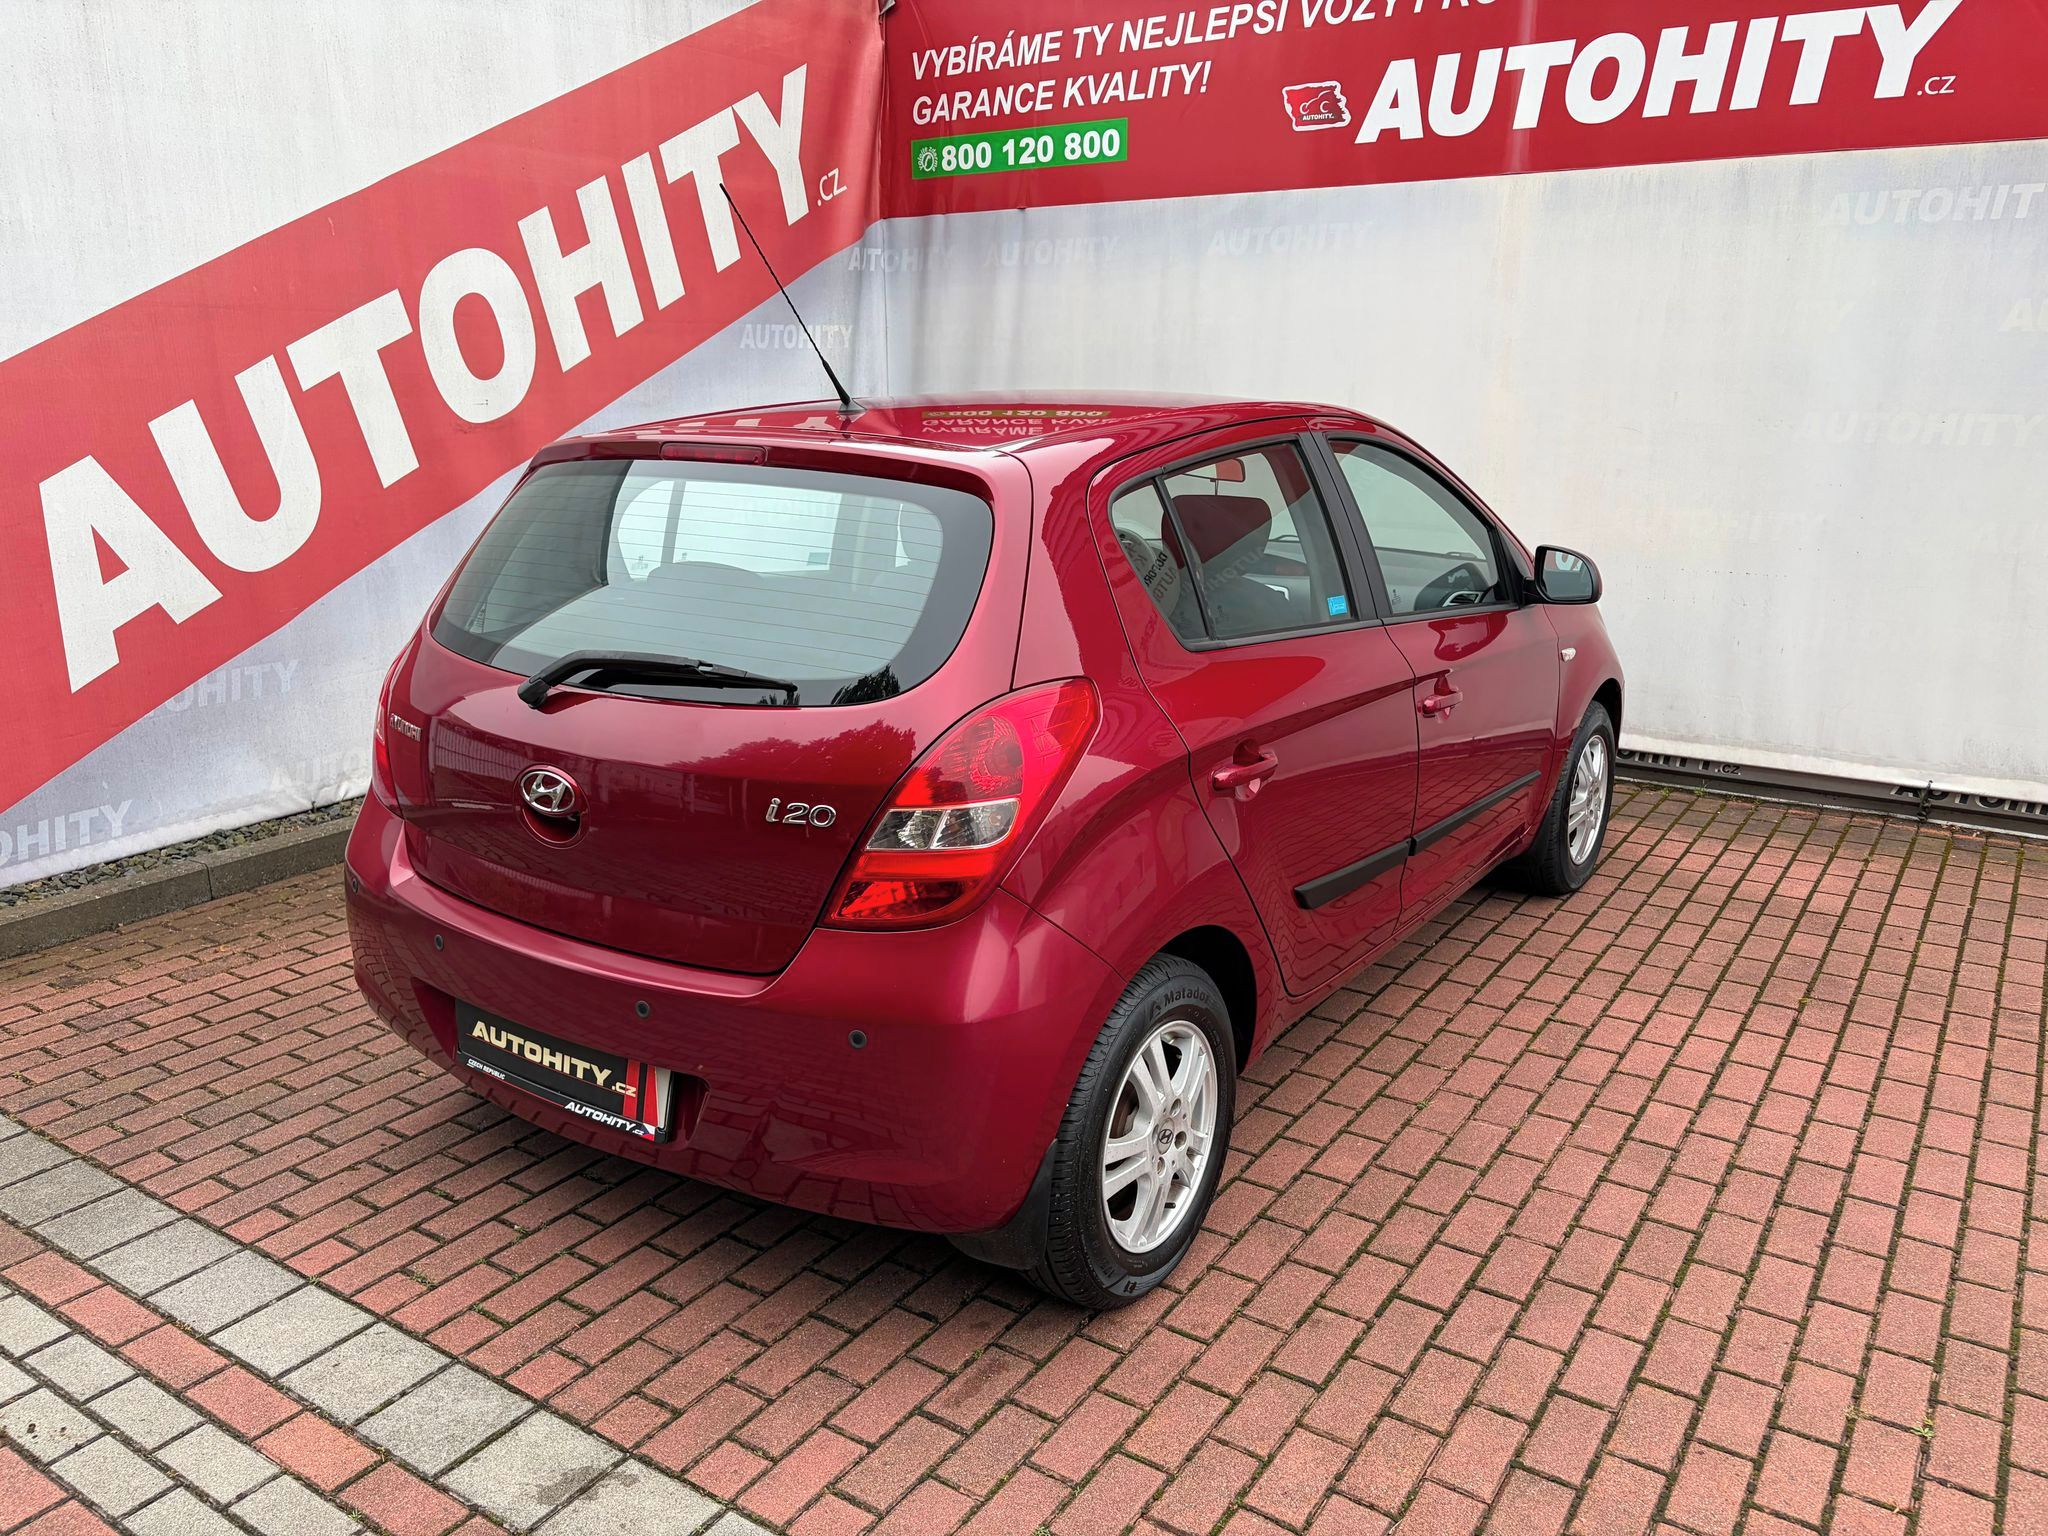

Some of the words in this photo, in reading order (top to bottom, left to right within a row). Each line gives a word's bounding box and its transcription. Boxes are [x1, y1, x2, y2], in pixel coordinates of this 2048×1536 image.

[912, 30, 1063, 81] VYBÍRÁME
[1073, 23, 1115, 59] TY
[912, 79, 1056, 126] GARANCE
[1062, 60, 1212, 108] KVALITY!
[941, 141, 992, 172] 800
[1002, 135, 1054, 166] 120
[1064, 128, 1121, 161] 800
[740, 323, 855, 350] AUTOHITY
[765, 797, 837, 828] i20
